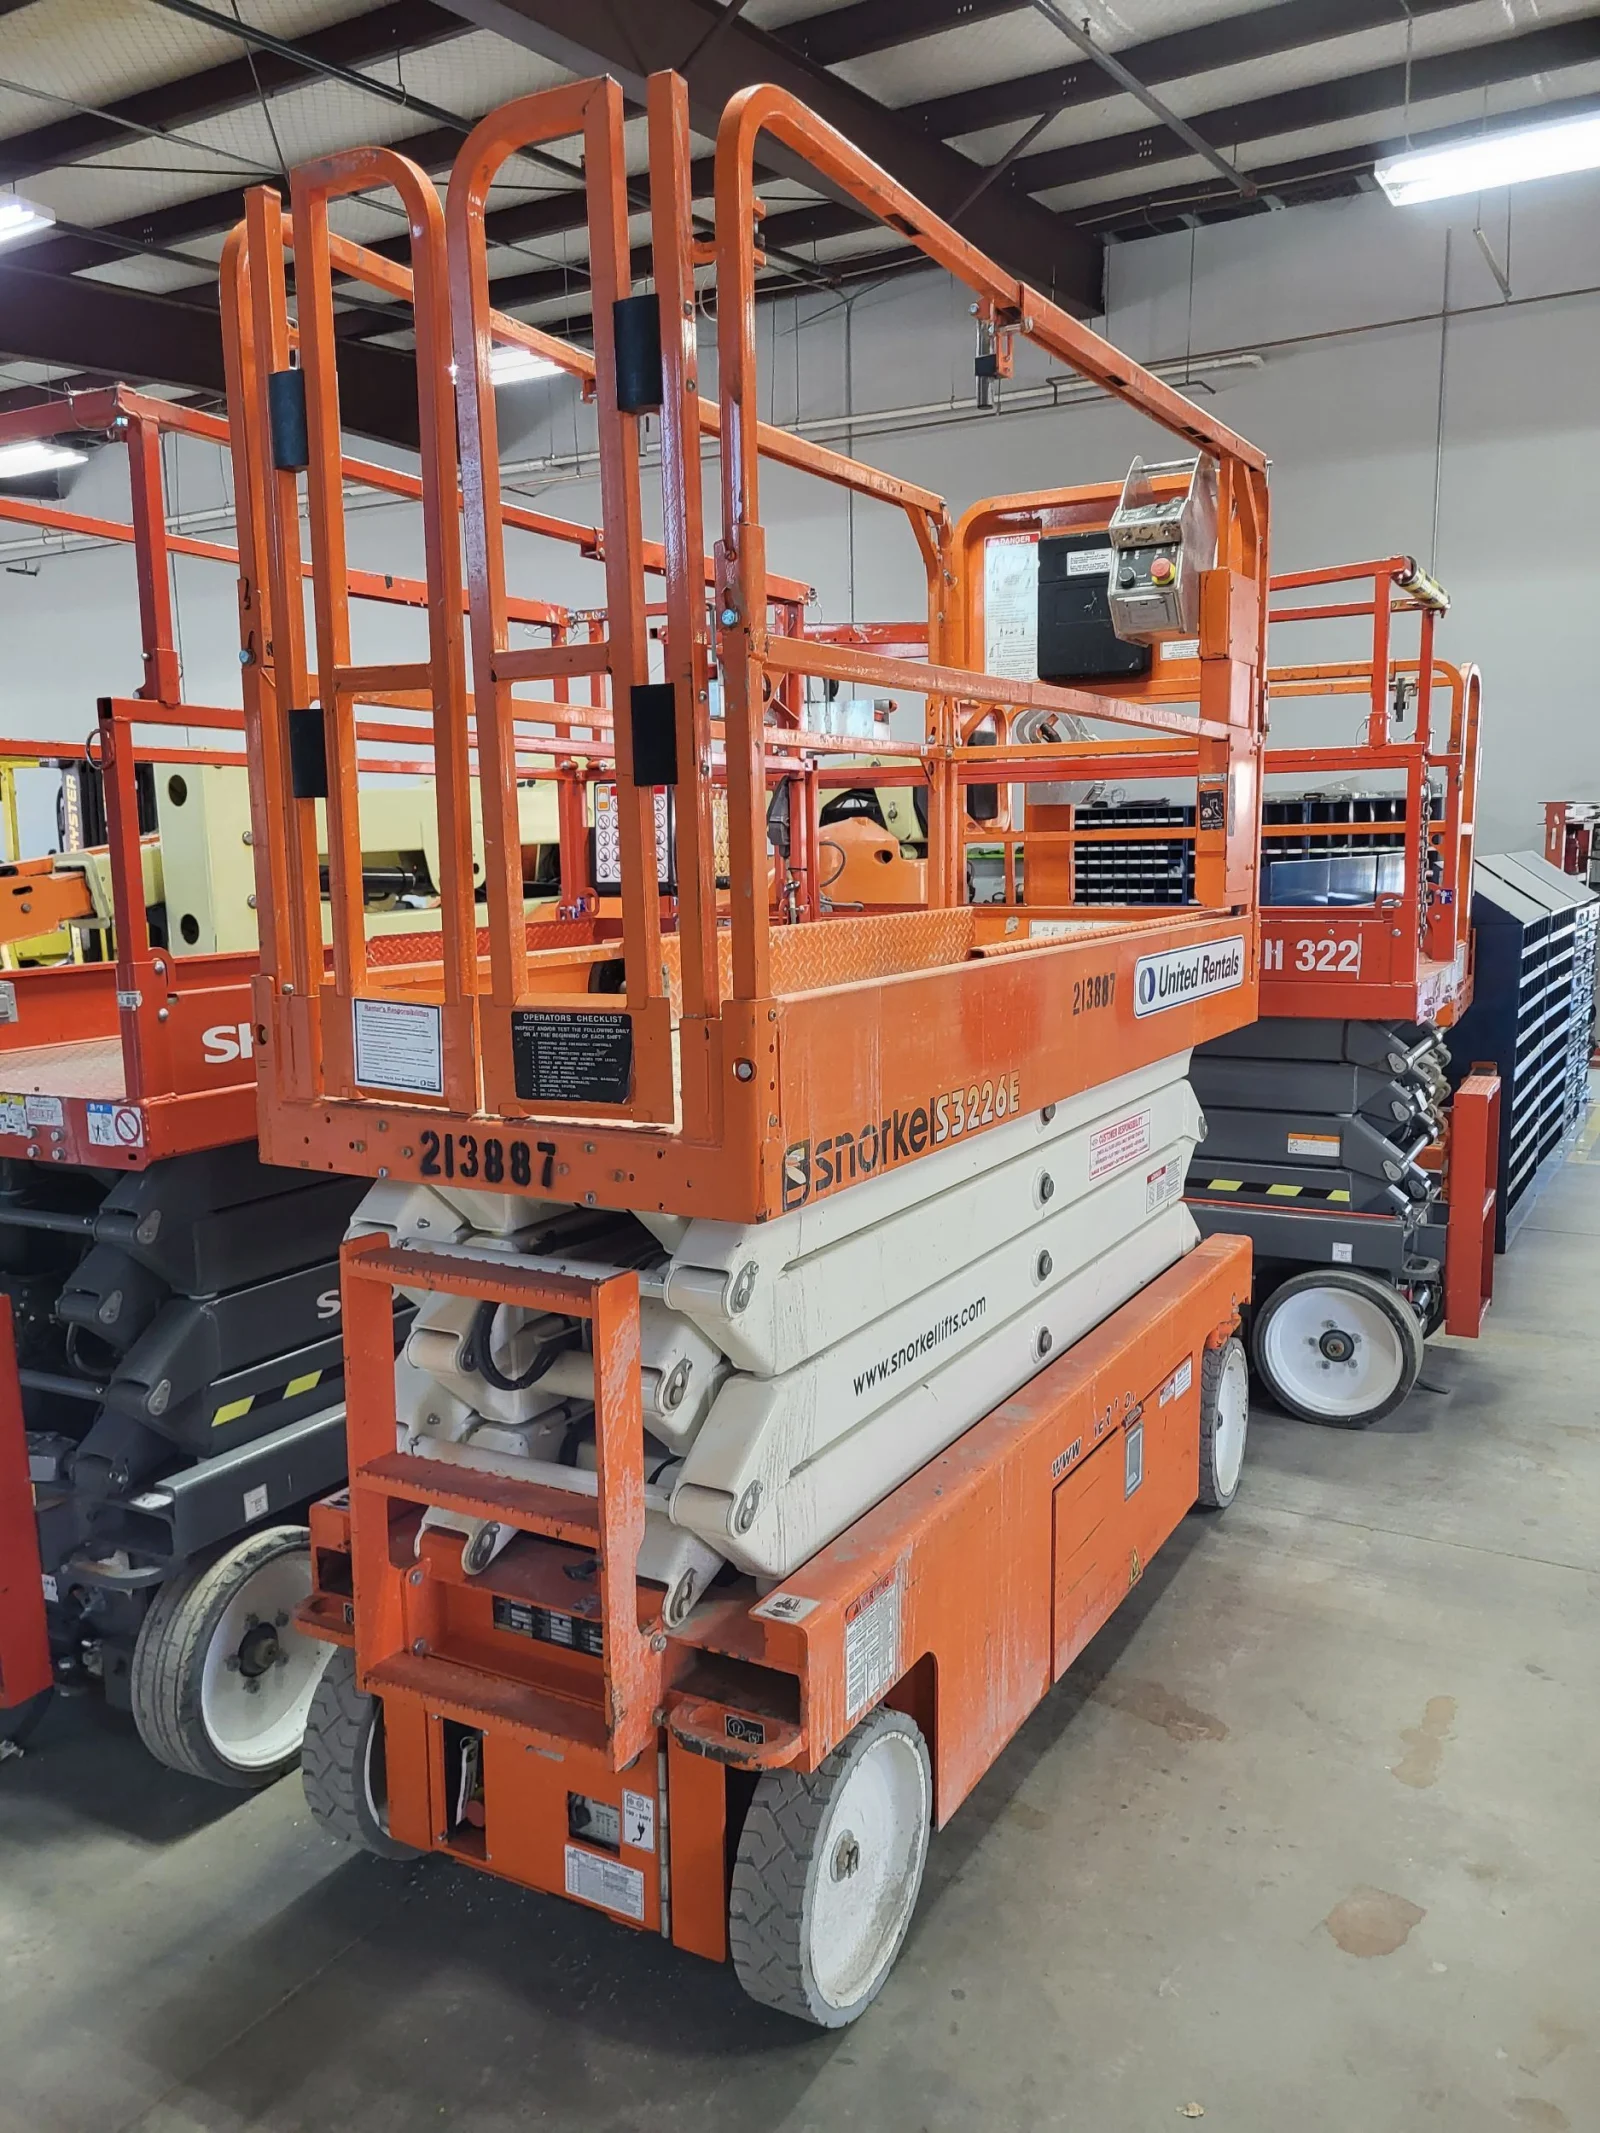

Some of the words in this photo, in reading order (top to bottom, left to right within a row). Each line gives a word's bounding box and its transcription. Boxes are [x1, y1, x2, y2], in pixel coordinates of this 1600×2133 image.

[1000, 535, 1031, 546] DANGER
[66, 774, 80, 854] HYSTER
[1073, 972, 1116, 1016] 213887
[1159, 957, 1199, 998] United
[1202, 948, 1239, 985] Rentals
[523, 1013, 572, 1022] OPERATORS
[576, 1015, 623, 1023] CHECKLIST
[815, 1097, 936, 1191] snorkel
[936, 1069, 1020, 1143] S3226E
[420, 1130, 556, 1188] 213887
[853, 1296, 986, 1397] www.snorkellifts.com
